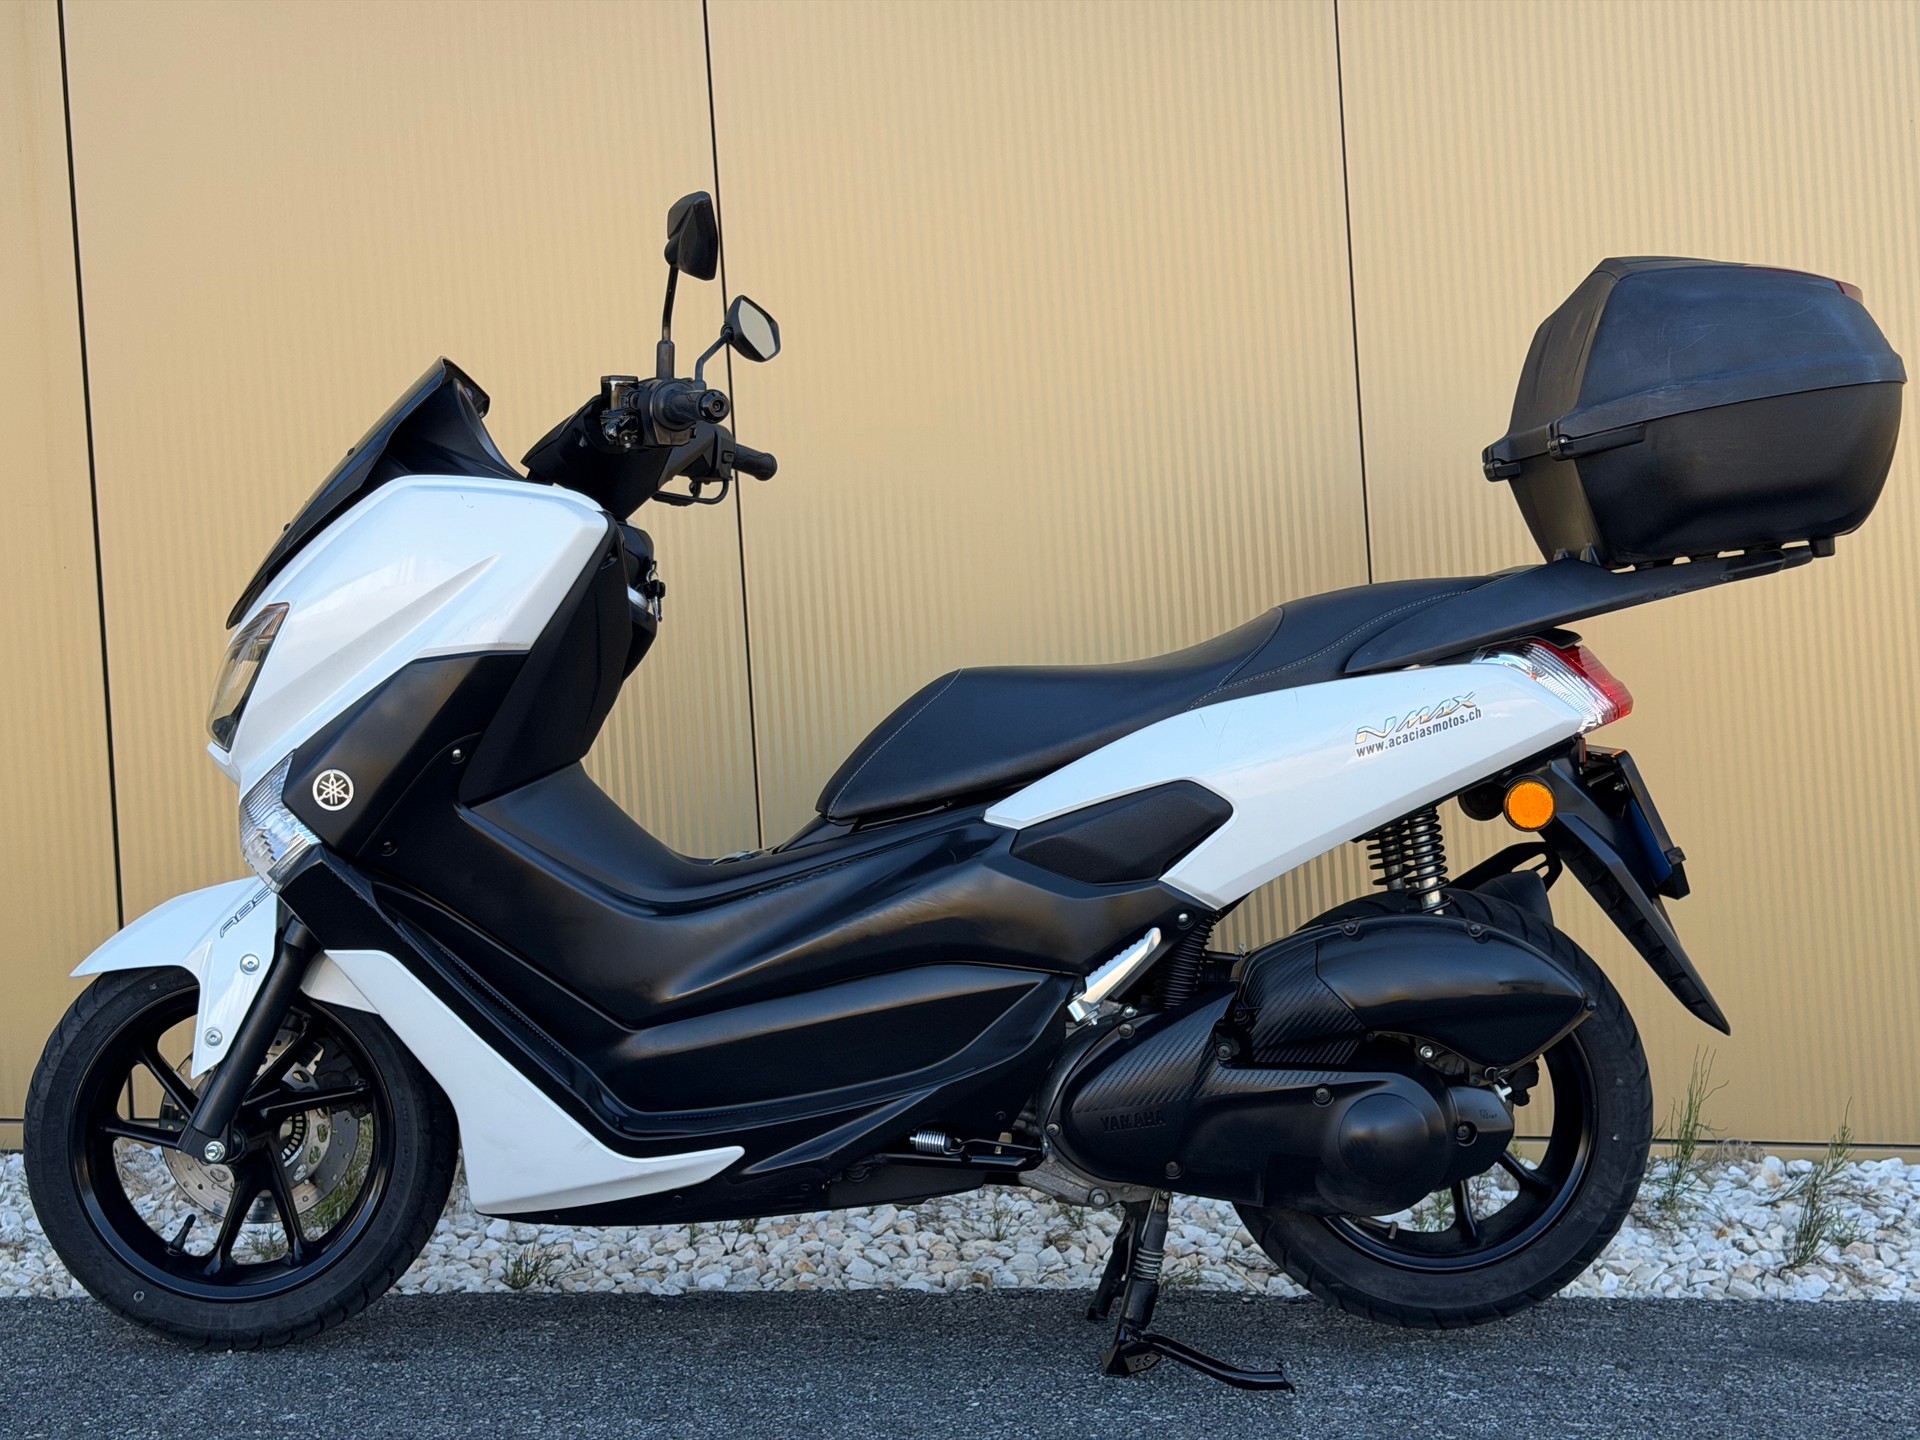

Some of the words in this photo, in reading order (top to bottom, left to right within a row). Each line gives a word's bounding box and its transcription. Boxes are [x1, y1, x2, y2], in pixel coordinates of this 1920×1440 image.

[1356, 707, 1482, 757] www.acaciasmotos.ch
[220, 885, 272, 938] ABS
[1099, 1109, 1167, 1133] YAMAHA
